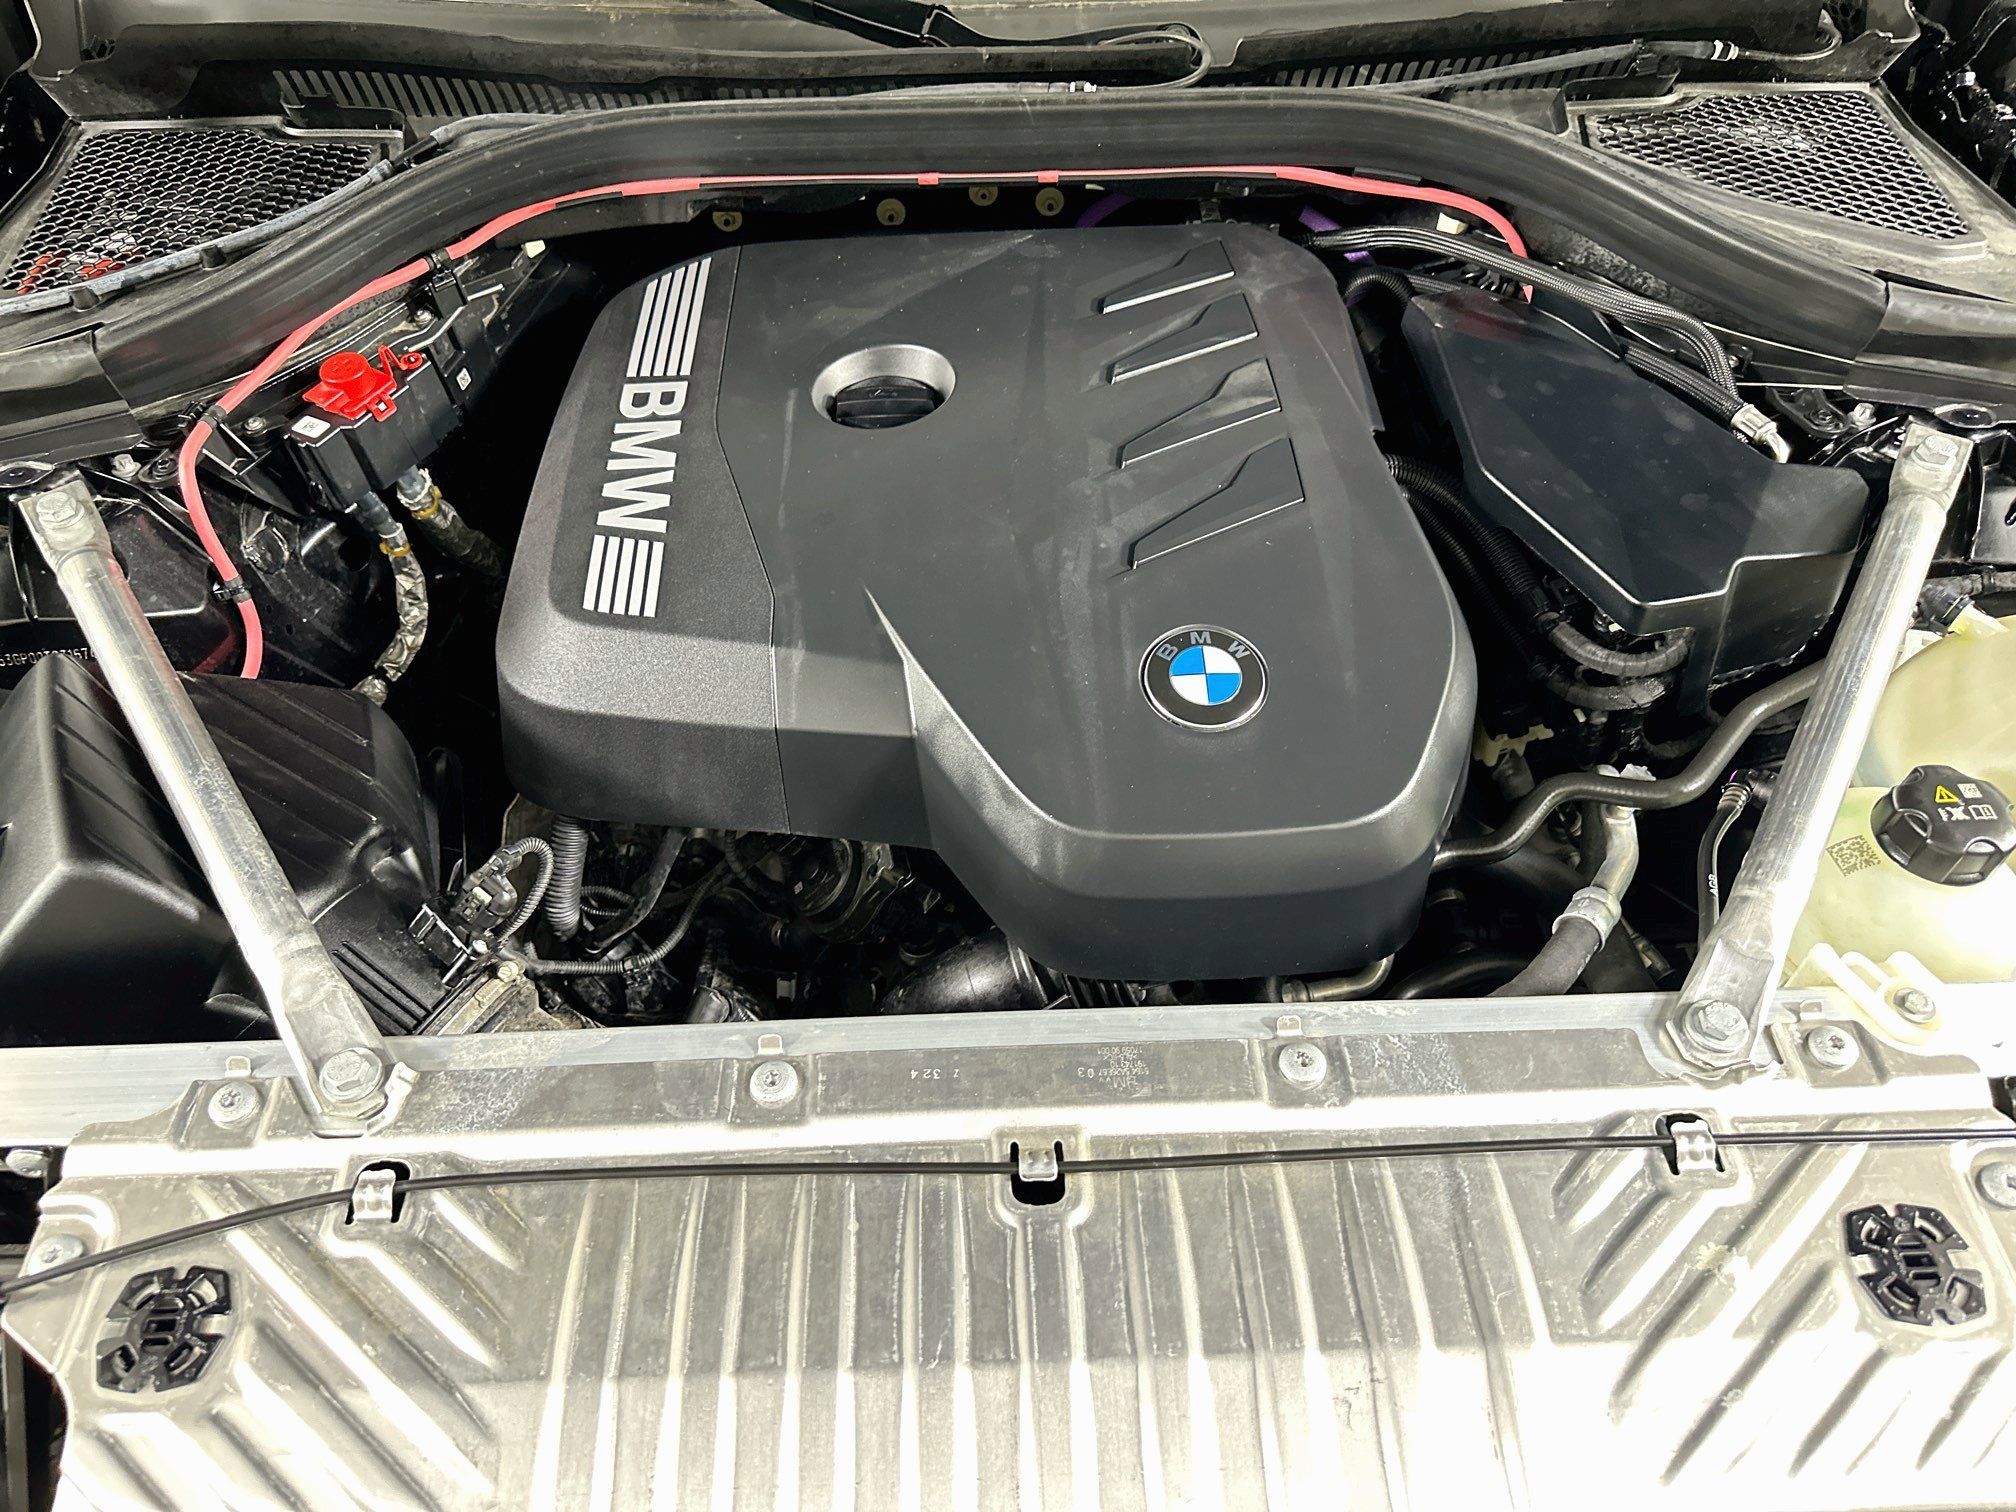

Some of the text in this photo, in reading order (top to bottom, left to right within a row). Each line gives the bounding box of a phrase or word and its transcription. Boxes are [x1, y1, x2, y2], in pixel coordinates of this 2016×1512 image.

[597, 380, 689, 533] BMW
[1155, 631, 1251, 662] BMW
[910, 1068, 941, 1080] 324
